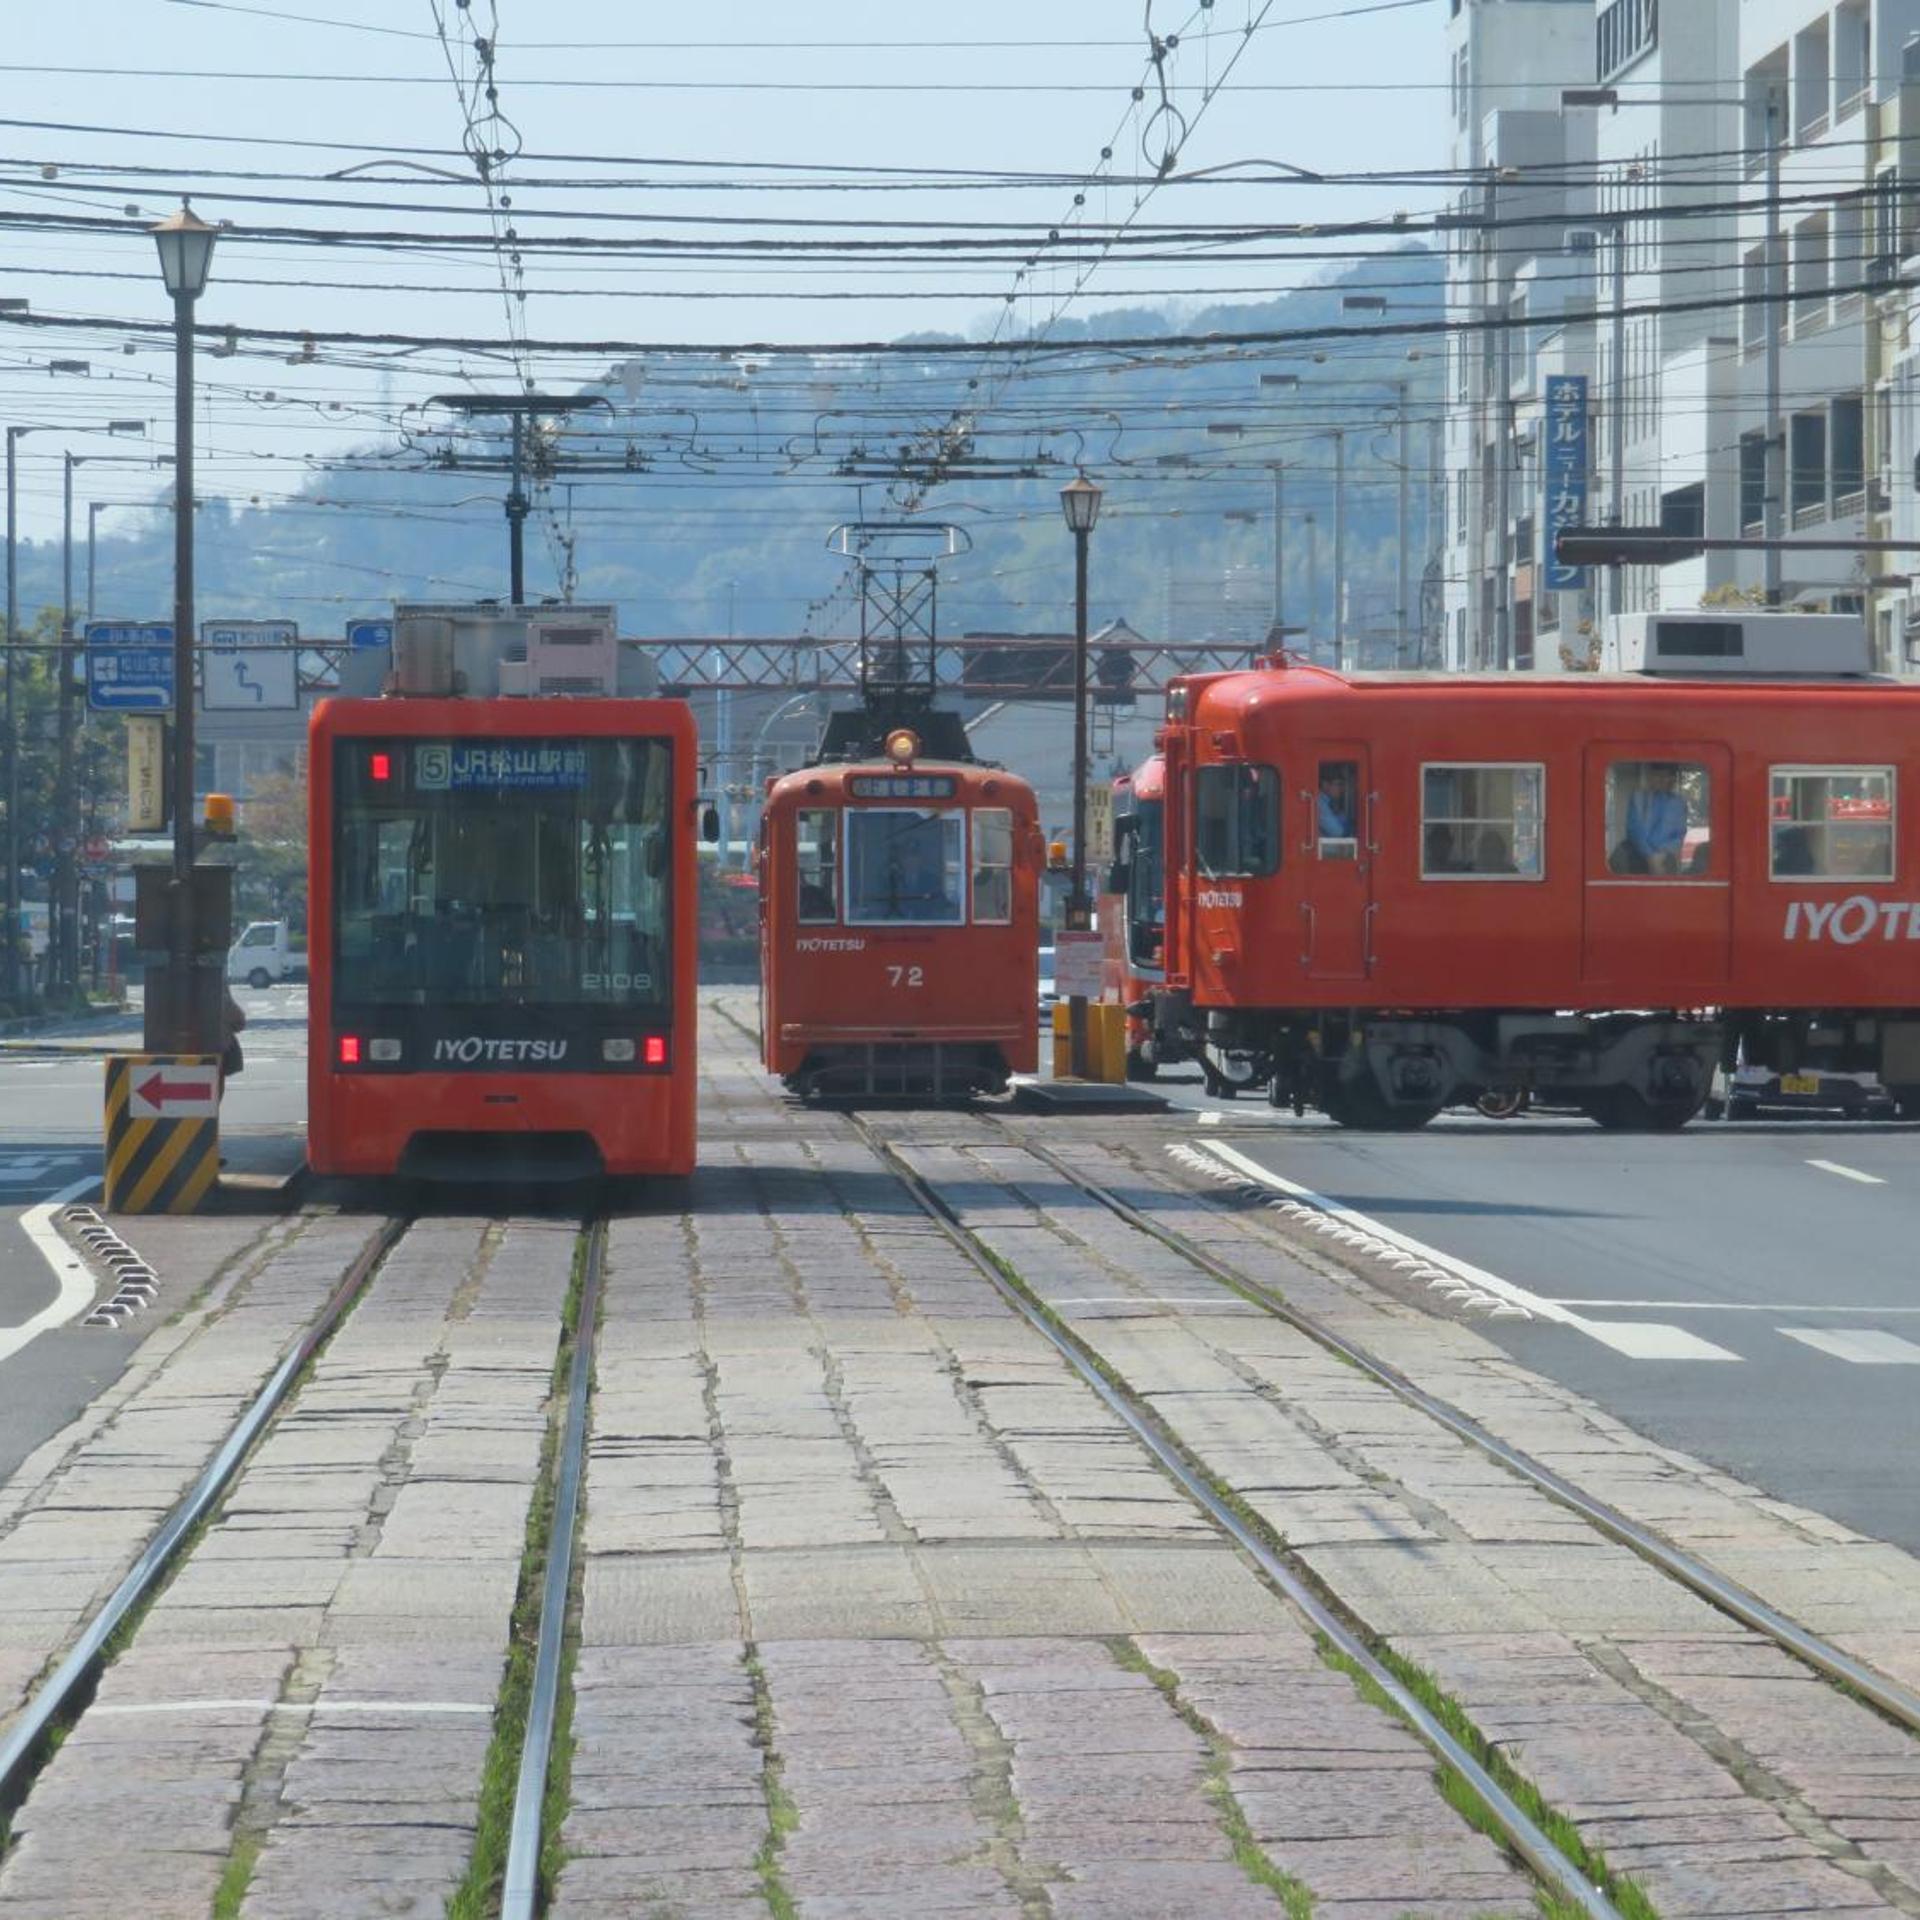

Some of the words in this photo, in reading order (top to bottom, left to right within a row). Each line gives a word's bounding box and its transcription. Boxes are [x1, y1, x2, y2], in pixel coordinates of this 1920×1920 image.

[1551, 381, 1581, 583] ホテルニューカジラ
[424, 753, 444, 777] 5
[797, 938, 865, 951] IYOTETSU
[583, 973, 651, 989] 2108
[887, 966, 922, 986] 72
[434, 1037, 567, 1062] IYOTETSU
